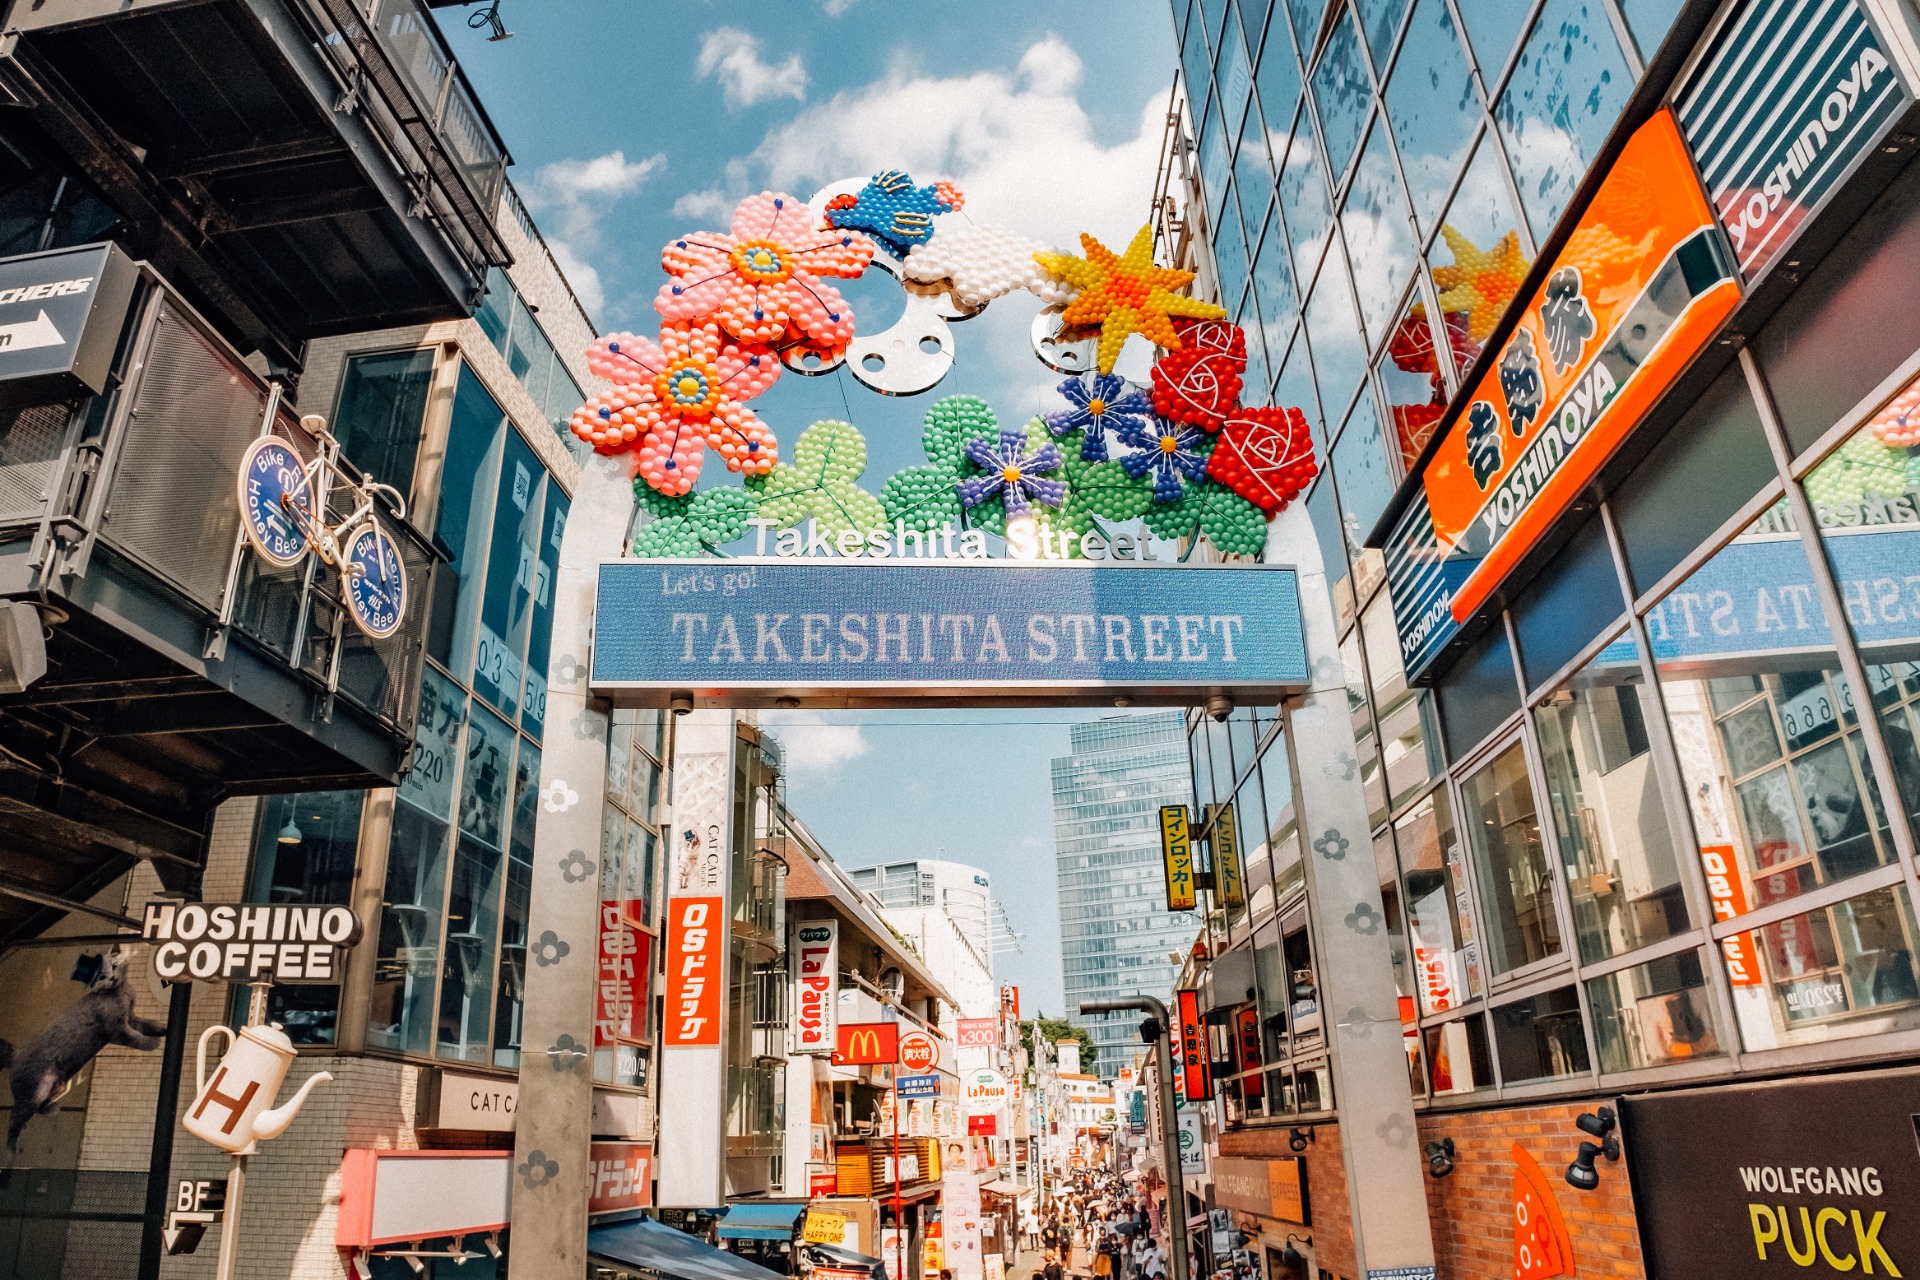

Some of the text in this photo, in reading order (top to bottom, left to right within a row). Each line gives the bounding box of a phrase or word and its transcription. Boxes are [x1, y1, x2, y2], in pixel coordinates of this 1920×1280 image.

[1728, 47, 1889, 253] YOSHINOYA
[1466, 266, 1598, 492] 吉野家
[256, 449, 284, 473] Bike
[1483, 361, 1618, 546] YOSHINOYA
[249, 479, 273, 546] Honey
[274, 537, 298, 554] Bee
[747, 518, 1158, 561] Takeshita Street
[662, 565, 757, 597] Let's go!
[351, 577, 370, 619] oney
[372, 611, 394, 627] Bee
[672, 612, 1243, 663] TAKESHITA STREET
[707, 824, 719, 888] CAT CAFE
[1167, 808, 1190, 896] コインロッカー
[1173, 897, 1193, 907] 3F
[143, 905, 354, 942] HOSHINO
[155, 941, 333, 979] COFFEE
[679, 904, 708, 1040] OSドラッグ
[799, 948, 830, 1043] La Pausa
[904, 1048, 930, 1060] 消火栓
[961, 1030, 994, 1044] ¥300
[193, 1066, 261, 1135] H
[470, 1091, 500, 1113] CAT
[968, 1085, 978, 1097] La
[979, 1084, 1005, 1097] Pausa
[177, 1181, 210, 1212] BF
[1739, 1166, 1883, 1196] WOLFGANG
[805, 1231, 843, 1243] HAPPY ONE
[807, 1217, 844, 1229] ハッピーワン
[1748, 1204, 1903, 1279] PUCK
